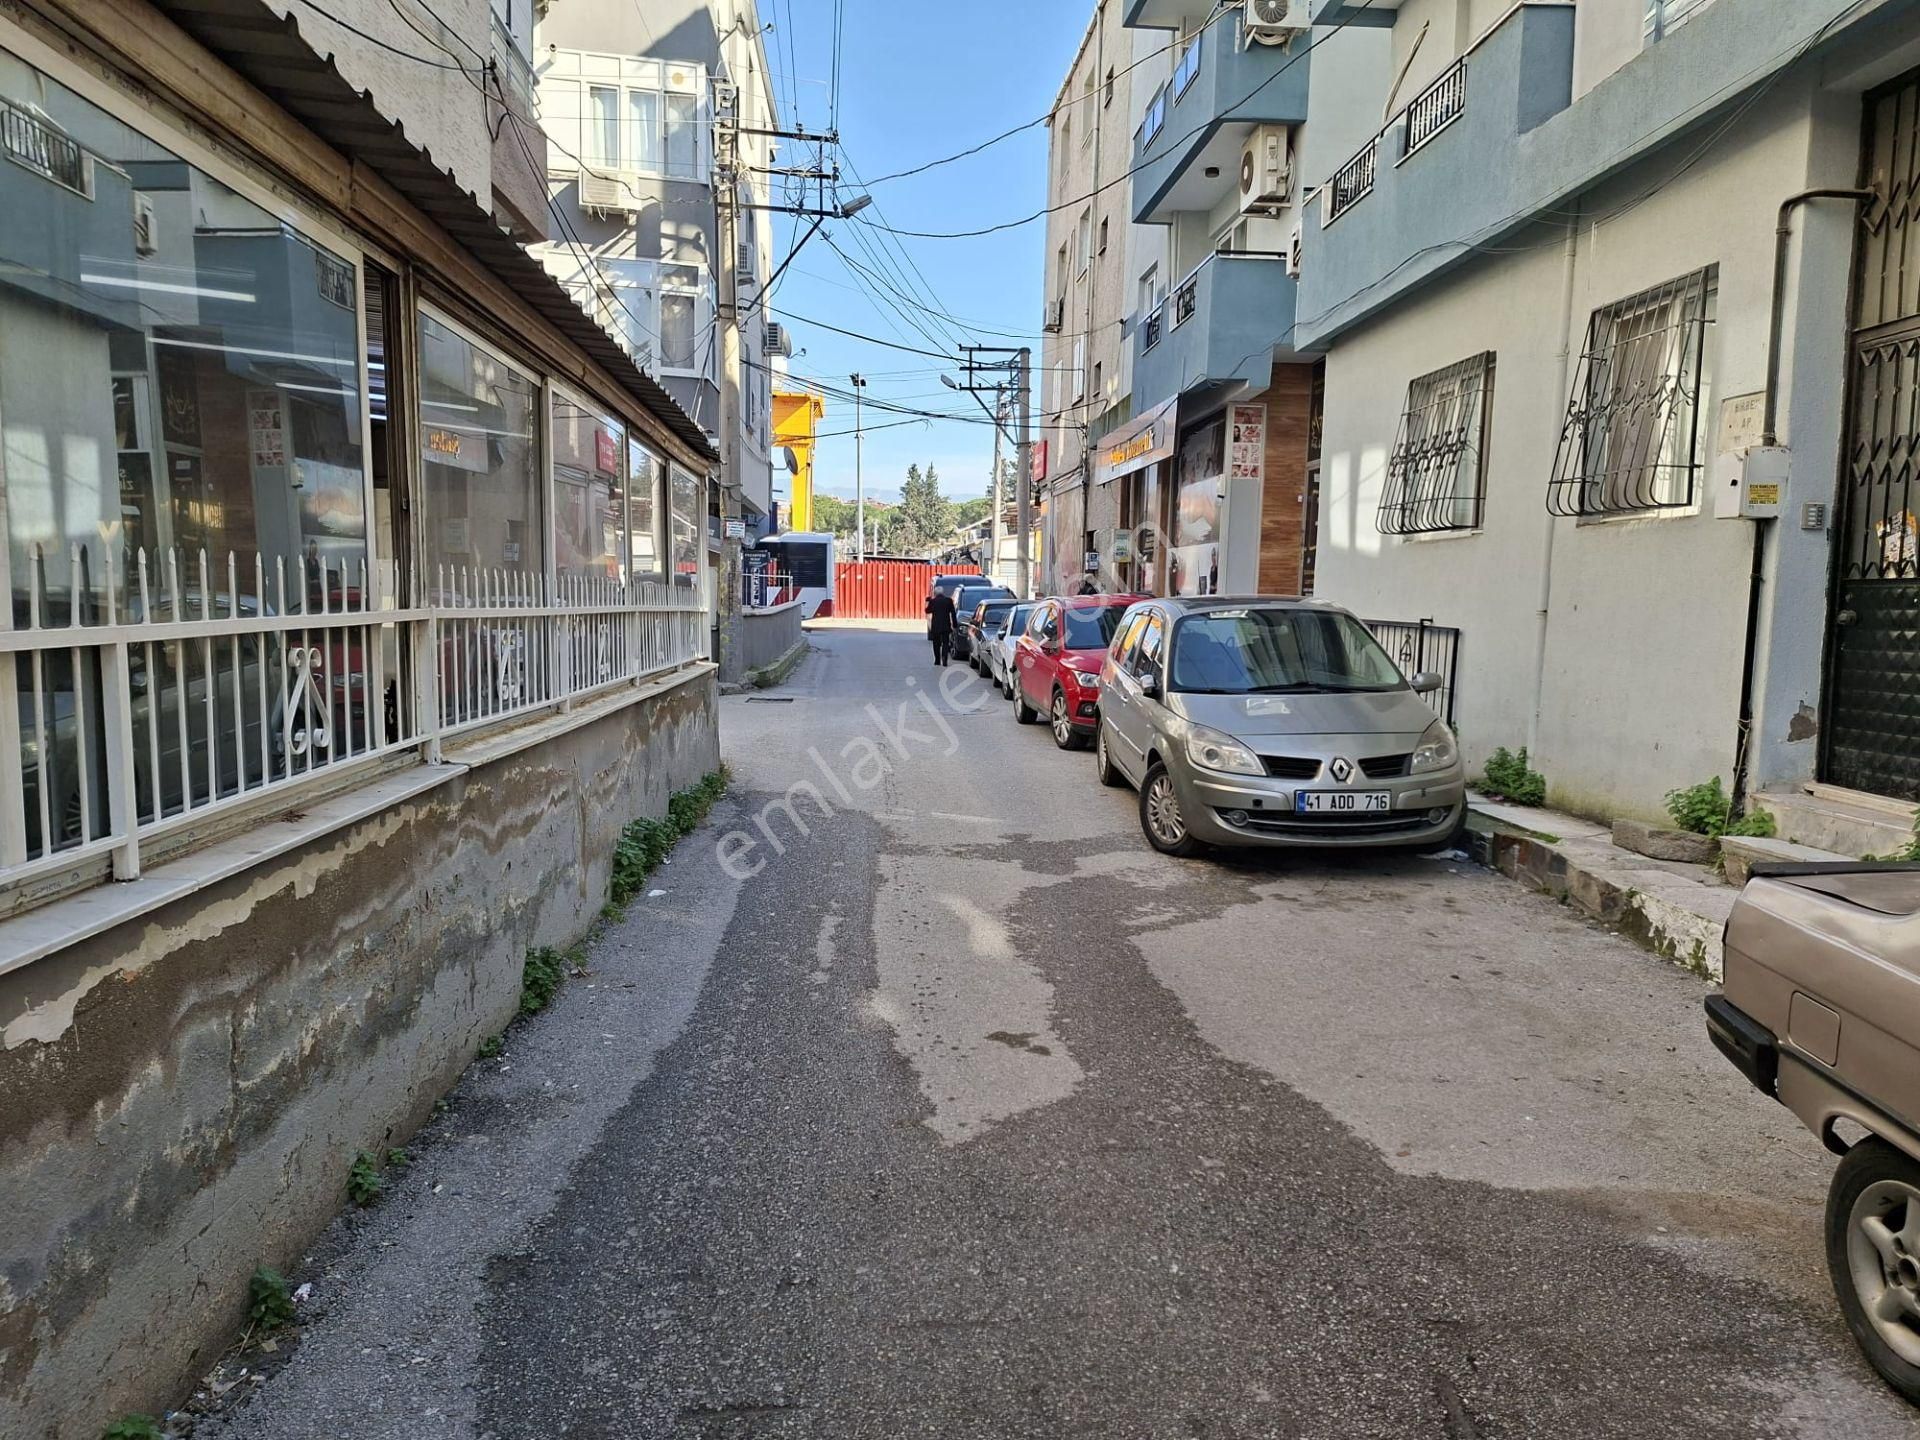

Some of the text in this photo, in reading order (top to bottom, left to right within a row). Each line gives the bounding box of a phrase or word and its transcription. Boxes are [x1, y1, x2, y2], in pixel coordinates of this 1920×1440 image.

[1306, 795, 1387, 809] 41 ADD 716
